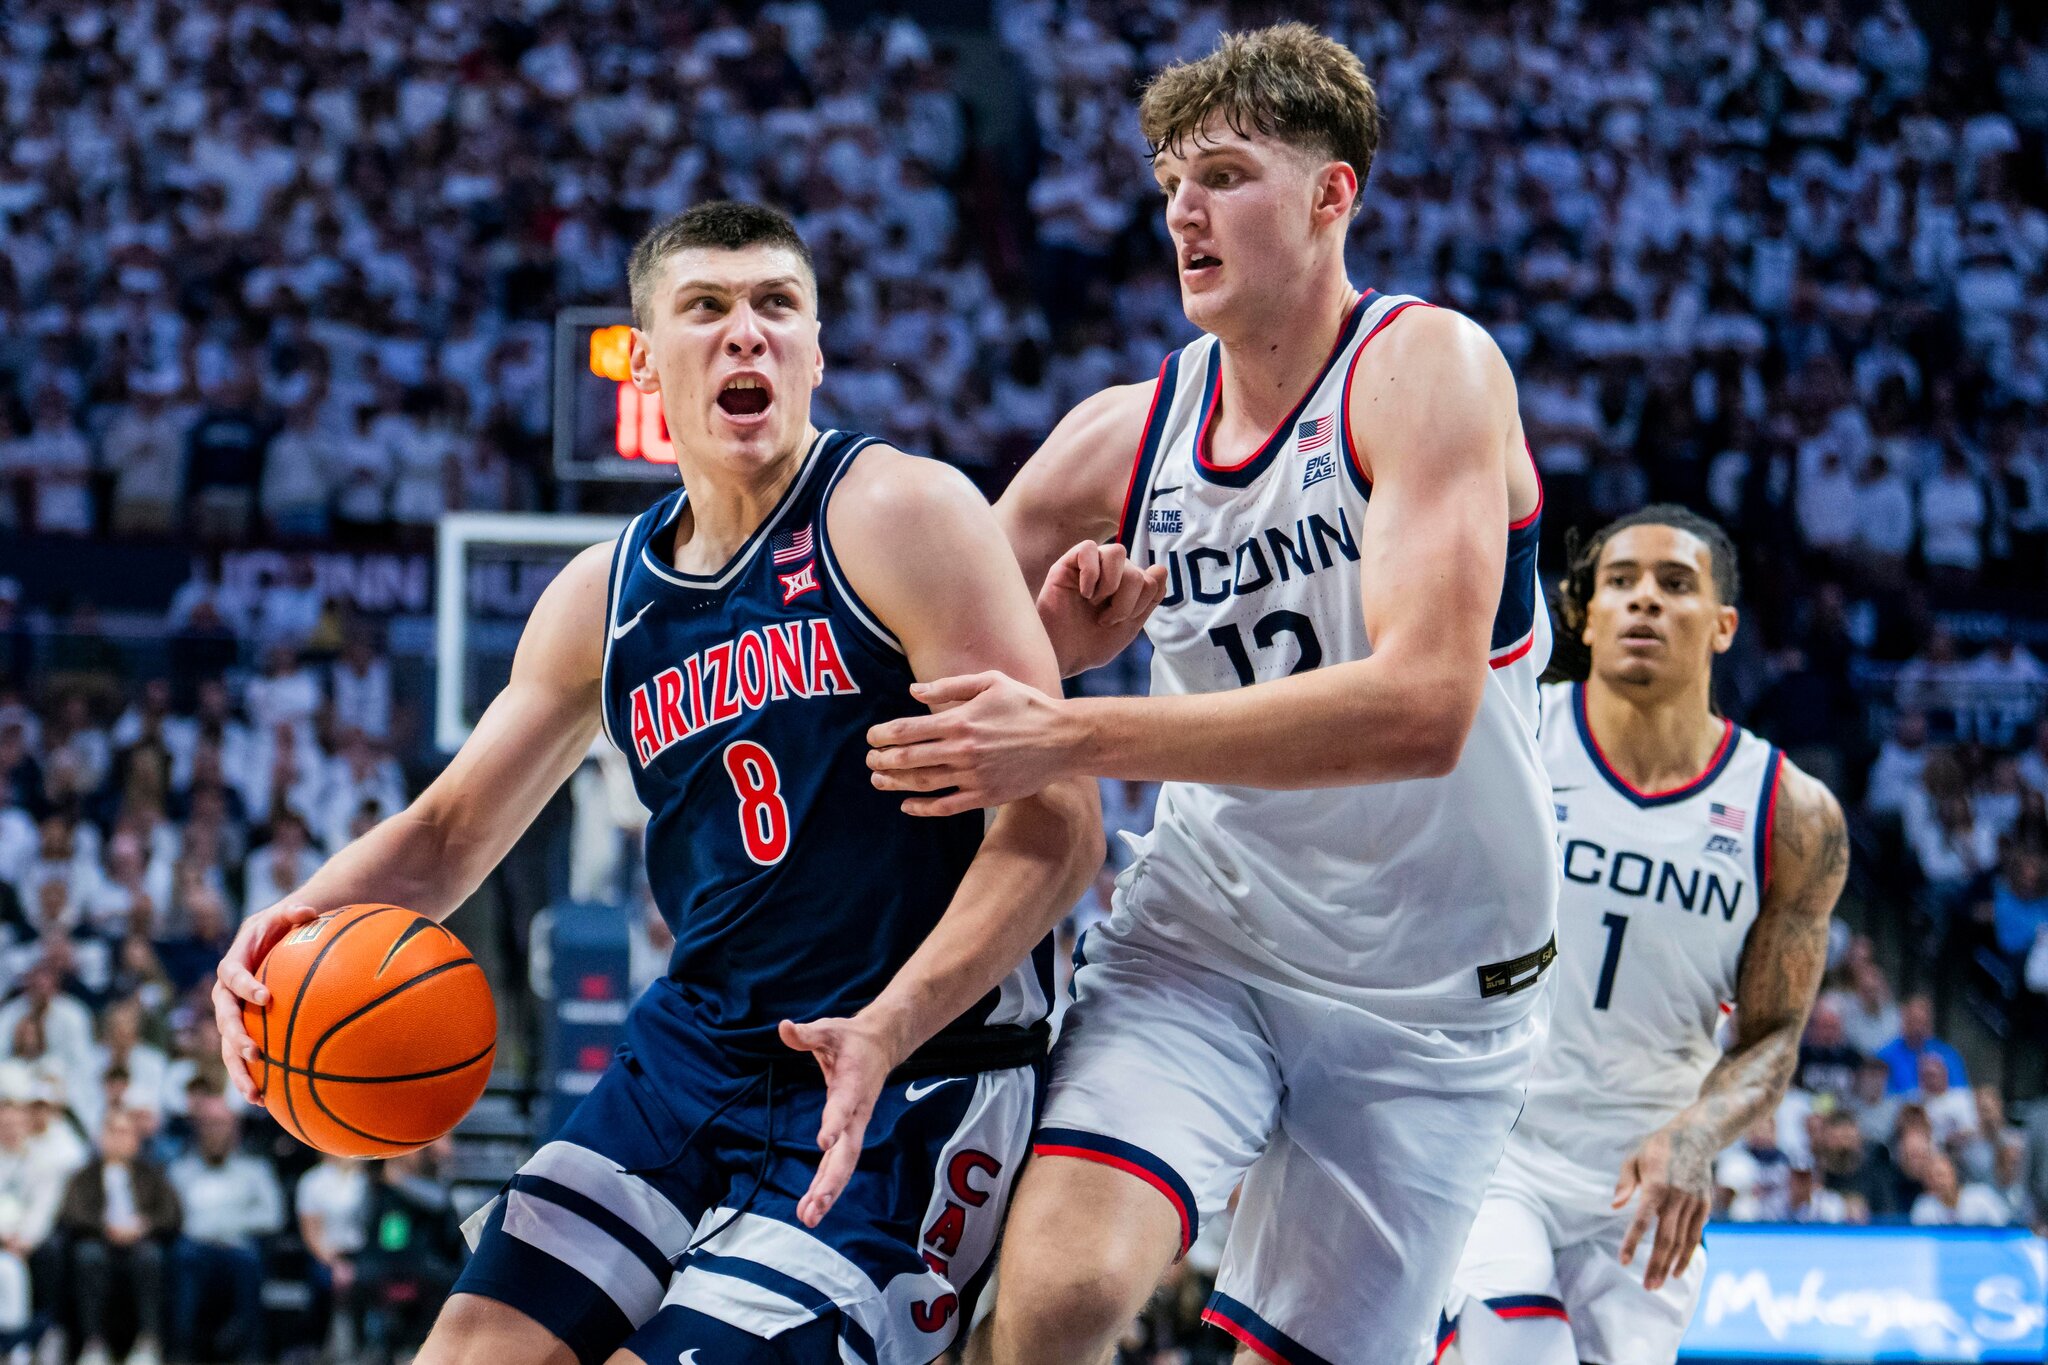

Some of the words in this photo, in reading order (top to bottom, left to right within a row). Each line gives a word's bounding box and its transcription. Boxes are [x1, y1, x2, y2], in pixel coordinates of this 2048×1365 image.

[1303, 461, 1336, 484] EAST
[1305, 452, 1331, 471] BIG
[1148, 507, 1361, 606] UCONN
[1161, 510, 1182, 521] THE
[1209, 609, 1322, 687] 12
[630, 619, 860, 769] ARIZONA
[723, 740, 790, 866] 8
[1560, 839, 1744, 922] CONN
[1593, 911, 1630, 1011] 1
